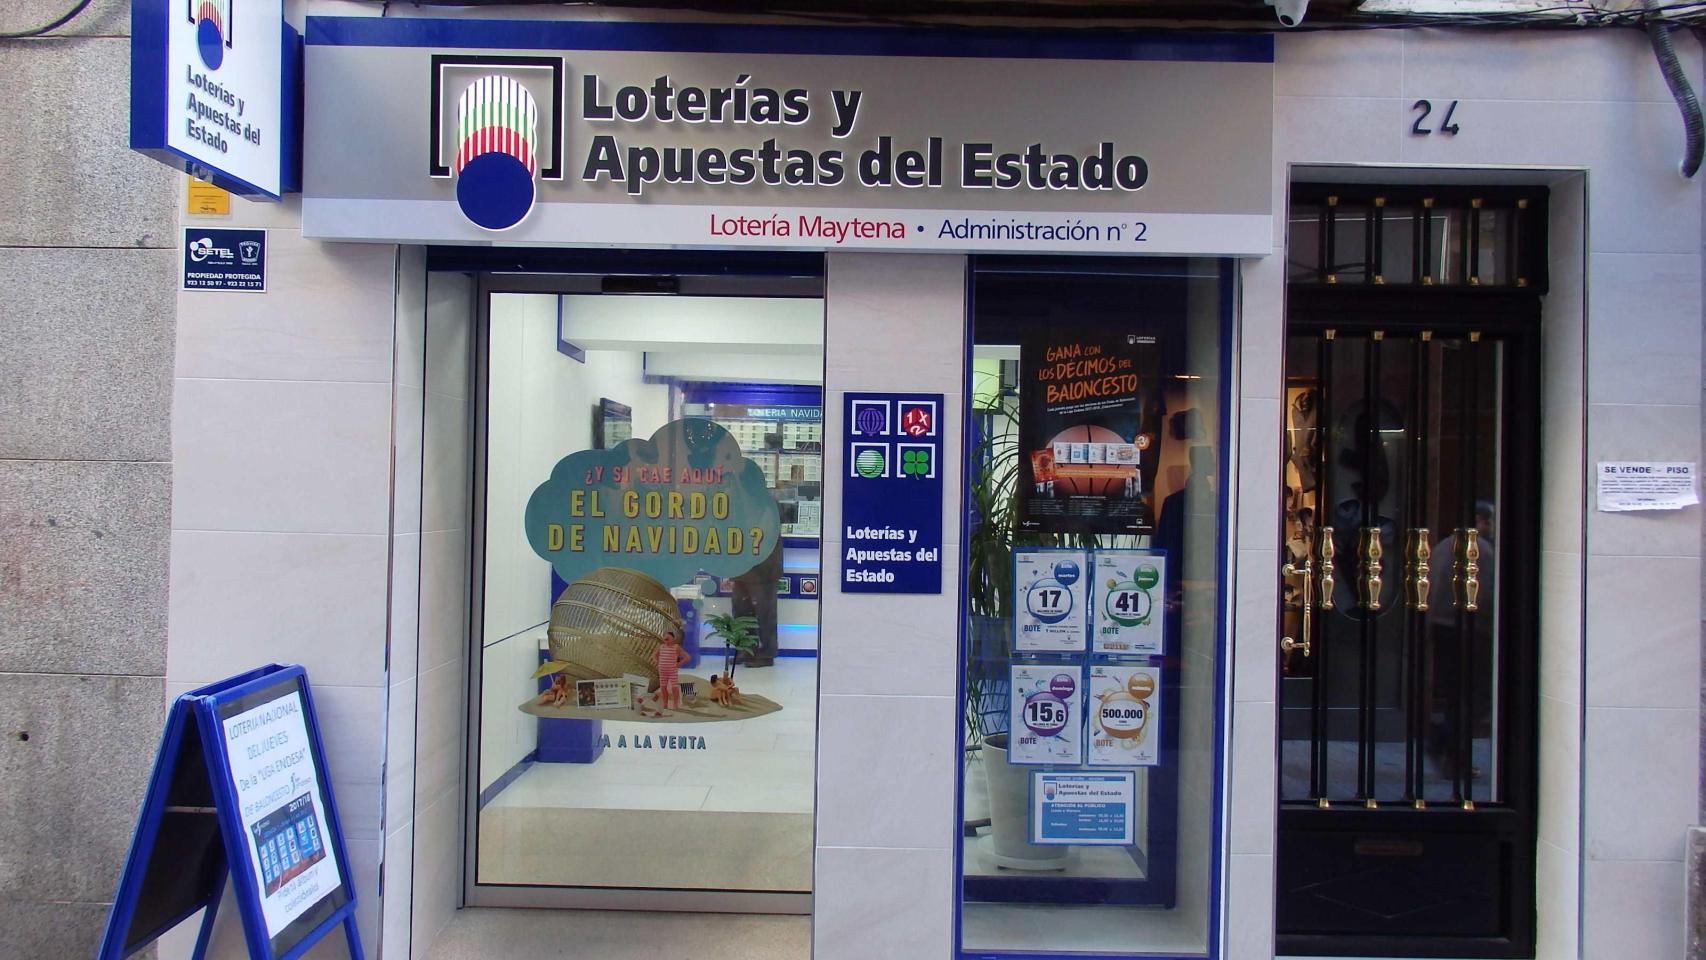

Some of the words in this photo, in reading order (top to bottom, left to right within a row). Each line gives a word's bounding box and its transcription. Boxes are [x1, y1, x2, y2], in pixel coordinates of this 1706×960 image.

[238, 98, 245, 117] y
[583, 73, 810, 124] Loterías
[830, 89, 863, 139] y
[187, 92, 241, 135] Apuestas
[244, 123, 260, 146] del
[1411, 99, 1461, 136] 24
[187, 117, 228, 153] Estado
[582, 134, 845, 196] Apuestas
[857, 135, 944, 189] del
[960, 141, 1150, 192] Estado
[710, 213, 791, 237] Lotería
[798, 215, 906, 241] Maytena
[938, 217, 1100, 242] Administración
[1134, 222, 1149, 242] 2
[1047, 343, 1082, 362] GANA
[1084, 345, 1101, 357] CON
[1038, 368, 1055, 381] LOS
[1118, 359, 1132, 369] DEL
[1046, 373, 1138, 404] BALONCESTO
[584, 465, 605, 486] ¿Y
[613, 466, 631, 484] SI
[639, 465, 673, 484] CAE
[680, 464, 725, 485] AQUÍ
[1604, 466, 1617, 474] SE
[1620, 466, 1652, 474] VENDE
[1666, 466, 1689, 474] PISO
[571, 489, 606, 518] EL
[623, 489, 730, 521] GORDO
[548, 524, 585, 552] DE
[602, 524, 765, 556] NAVIDAD?
[846, 525, 905, 541] Loterías
[908, 529, 918, 544] y
[846, 547, 912, 564] Apuestas
[915, 547, 938, 562] del
[846, 568, 895, 583] Estado
[1038, 589, 1062, 608] 17
[1115, 592, 1139, 613] 41
[1023, 624, 1041, 633] BOTE
[1102, 626, 1120, 635] BOTE
[259, 700, 297, 725] NACIONAL
[1028, 702, 1065, 724] 15,6
[1102, 708, 1143, 719] 500.000
[618, 734, 627, 748] A
[634, 734, 652, 749] LA
[659, 735, 706, 750] VENTA
[1020, 737, 1037, 745] BOTE
[1095, 739, 1114, 747] BOTE
